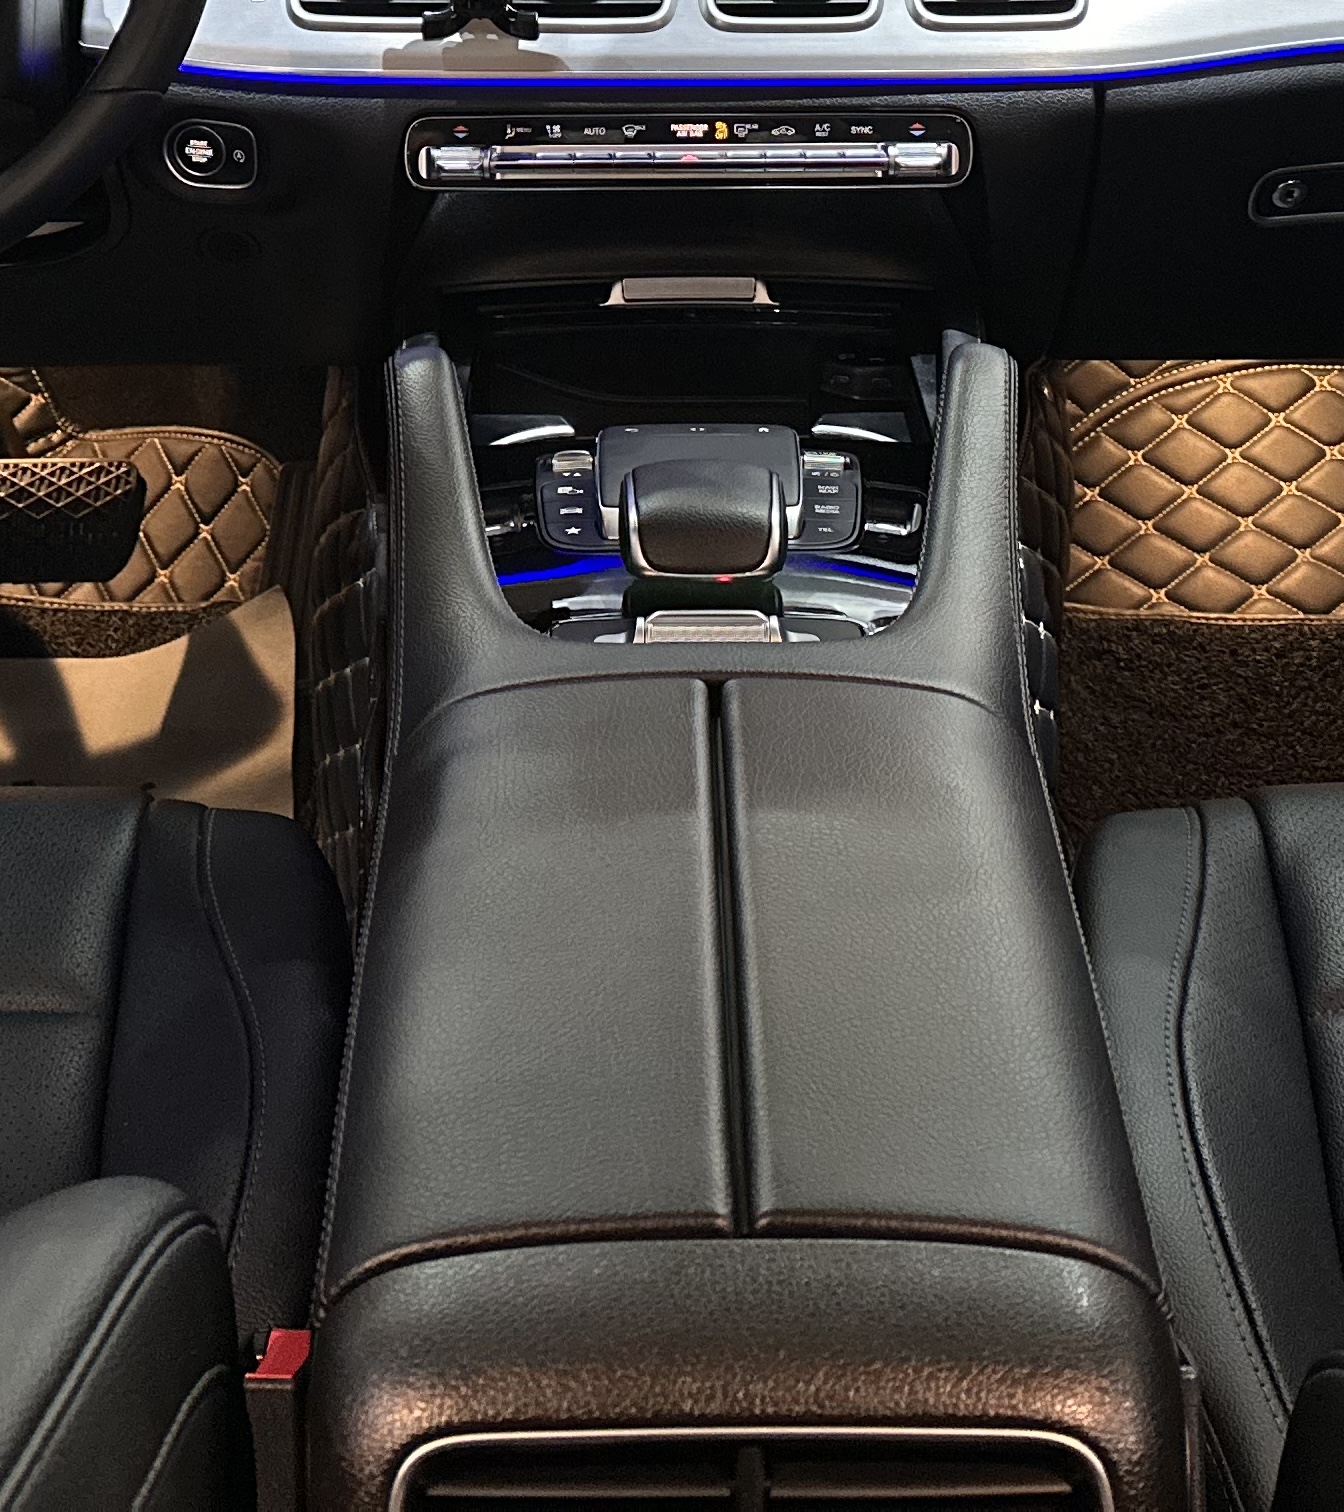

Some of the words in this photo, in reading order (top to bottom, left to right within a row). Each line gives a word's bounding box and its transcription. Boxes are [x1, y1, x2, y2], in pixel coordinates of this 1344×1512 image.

[583, 127, 606, 136] AUTO
[814, 123, 831, 132] A/C
[850, 126, 873, 135] SYNC
